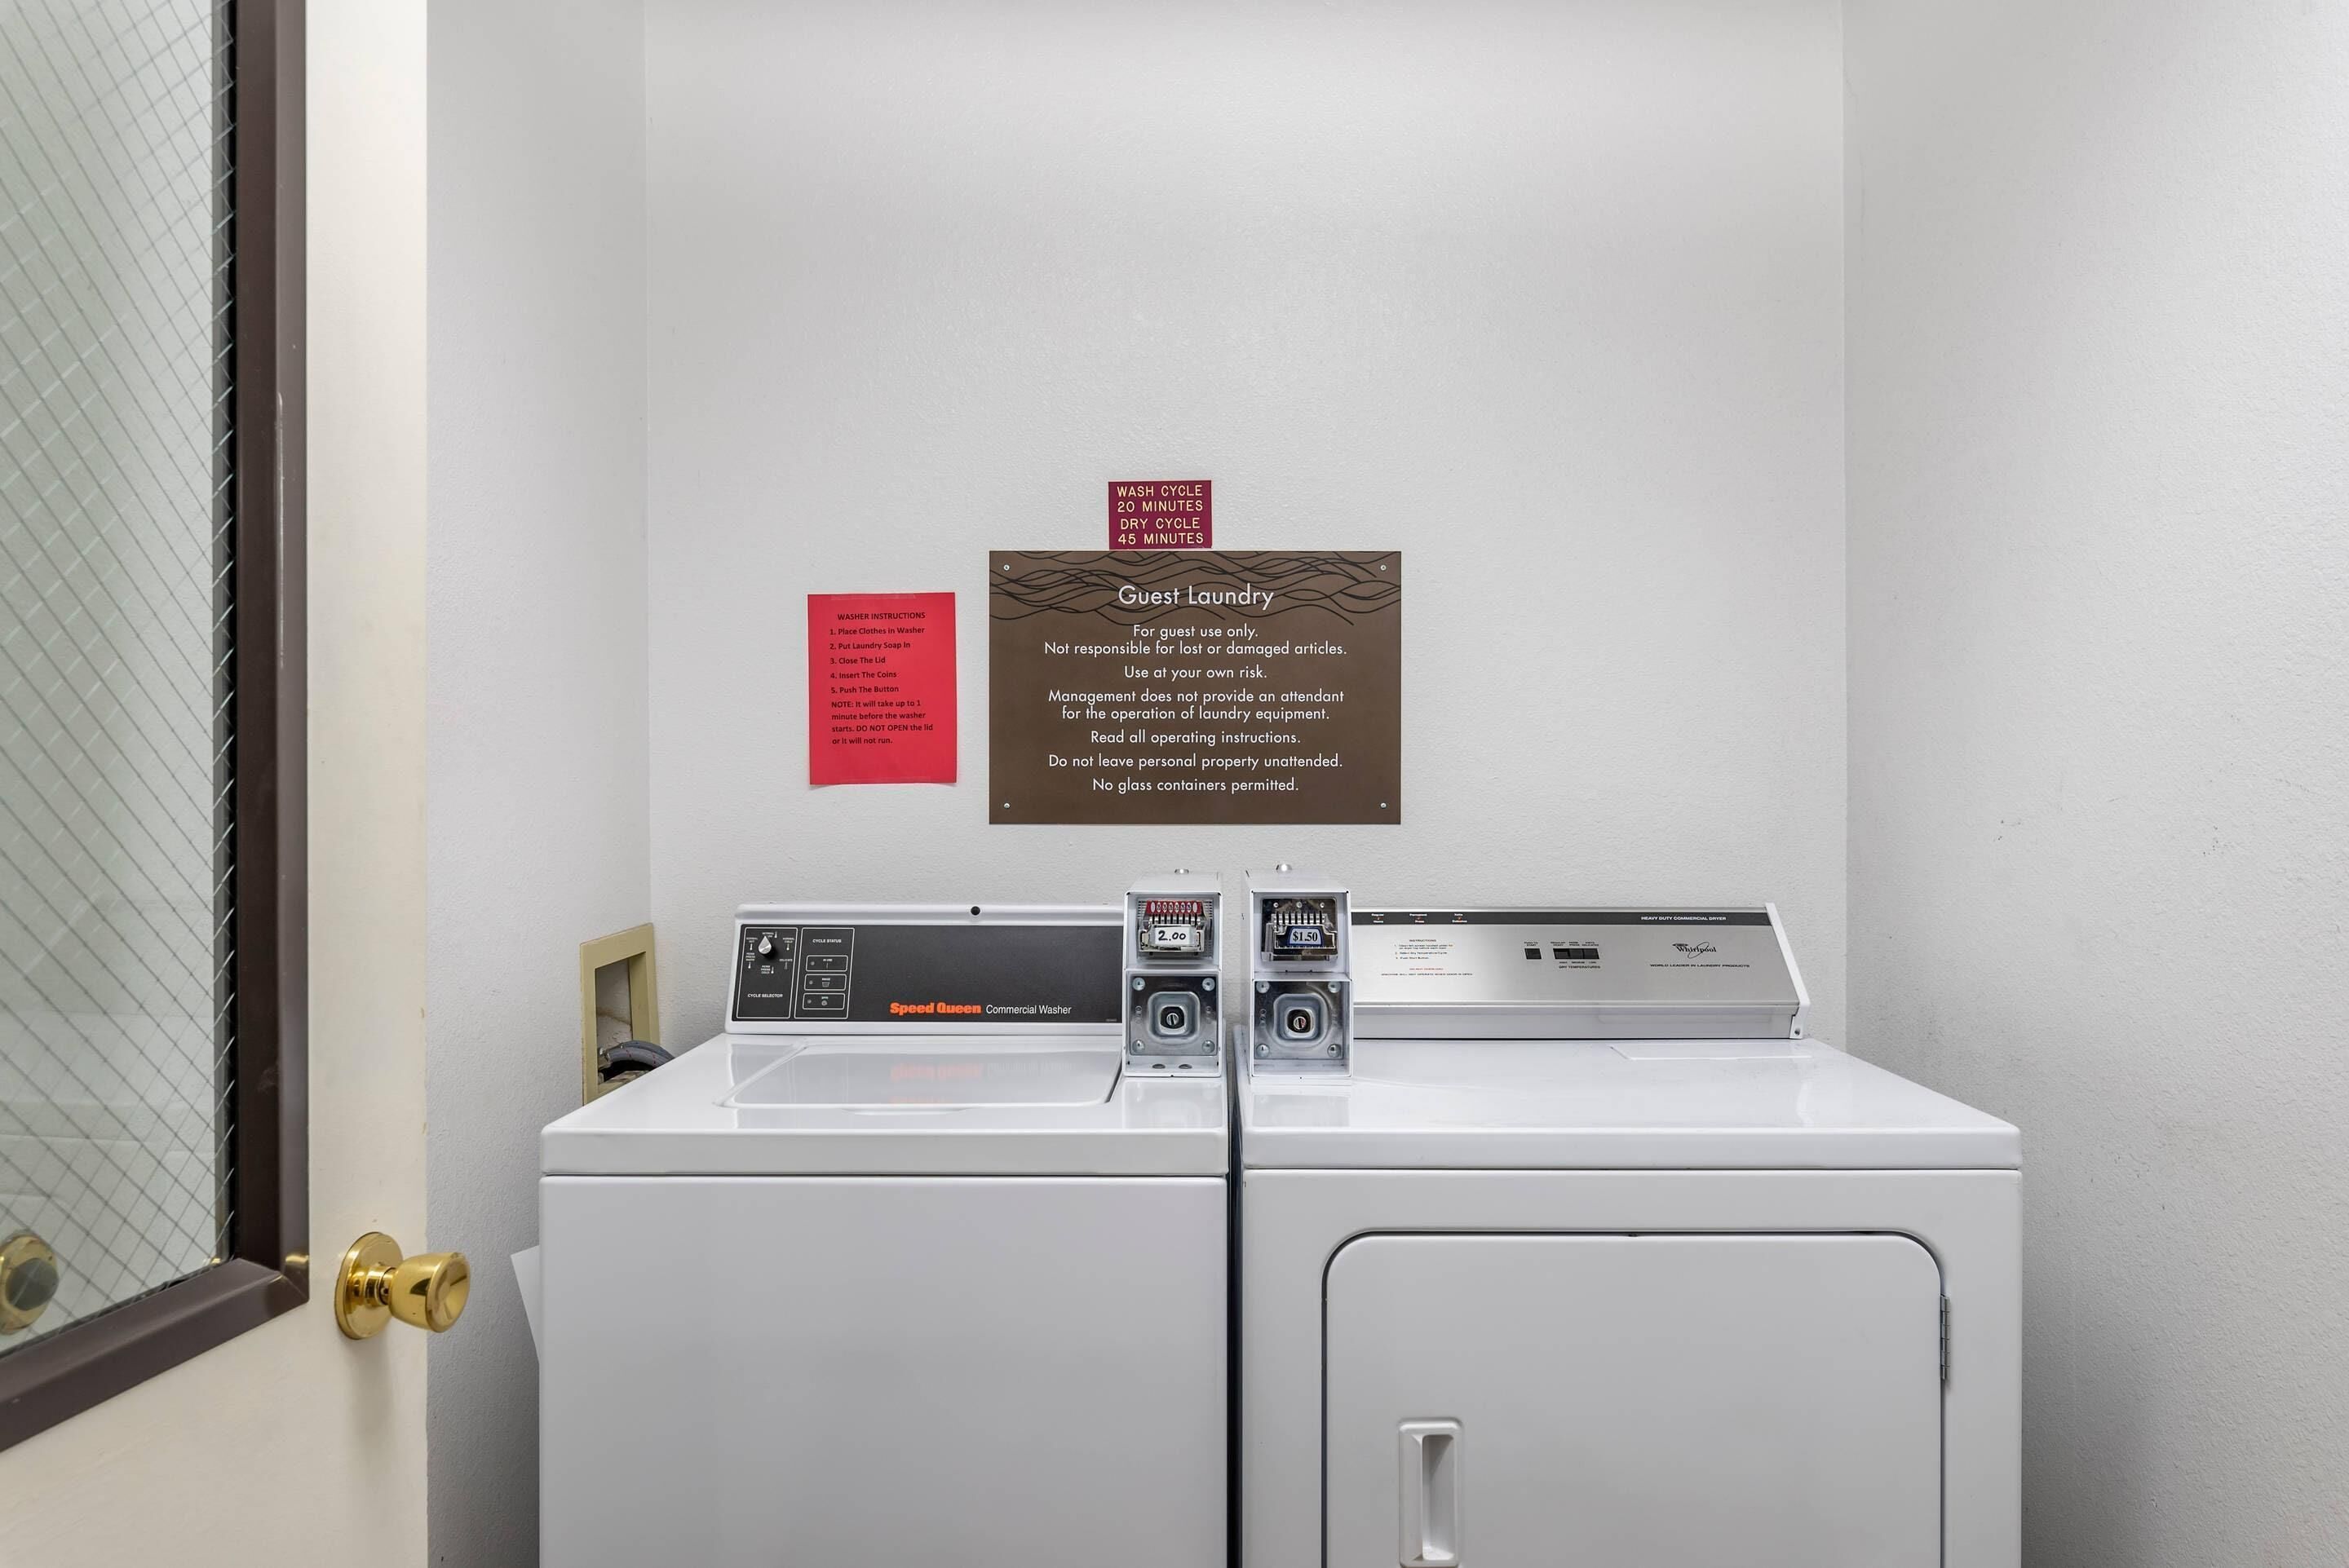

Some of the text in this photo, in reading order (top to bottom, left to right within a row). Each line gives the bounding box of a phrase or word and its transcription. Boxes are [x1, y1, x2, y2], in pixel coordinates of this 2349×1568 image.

[1117, 485, 1202, 497] WASH CYCLE
[1117, 501, 1202, 512] 20 MINUTES
[1121, 518, 1200, 529] DRY CYCLE
[1118, 532, 1203, 545] 45 MINUTES
[1119, 583, 1274, 610] Guest Laundry
[1133, 623, 1258, 641] For guest use only.
[1046, 640, 1346, 657] Not responsible for lost or damaged articles.
[1125, 665, 1148, 678] Use
[1154, 667, 1166, 678] at
[1171, 670, 1201, 682] your
[1240, 665, 1267, 678] risk.
[1049, 690, 1135, 706] Management
[1141, 688, 1171, 701] does
[1178, 689, 1201, 702] not
[1204, 688, 1254, 706] provide
[1281, 688, 1344, 701] attendant
[1063, 705, 1329, 722] for the operation of laundry equipment.
[1091, 730, 1300, 746] Read all operating instructions.
[1050, 753, 1342, 770] Do not leave personal property unattended.
[1093, 777, 1298, 794] No glass containers permitted.
[1158, 930, 1186, 941] 2.00
[1293, 930, 1317, 942] $1.50
[1674, 944, 1716, 955] Whirlpool
[891, 1003, 980, 1015] Speed Queen
[986, 1005, 1072, 1014] Commercial Washer
